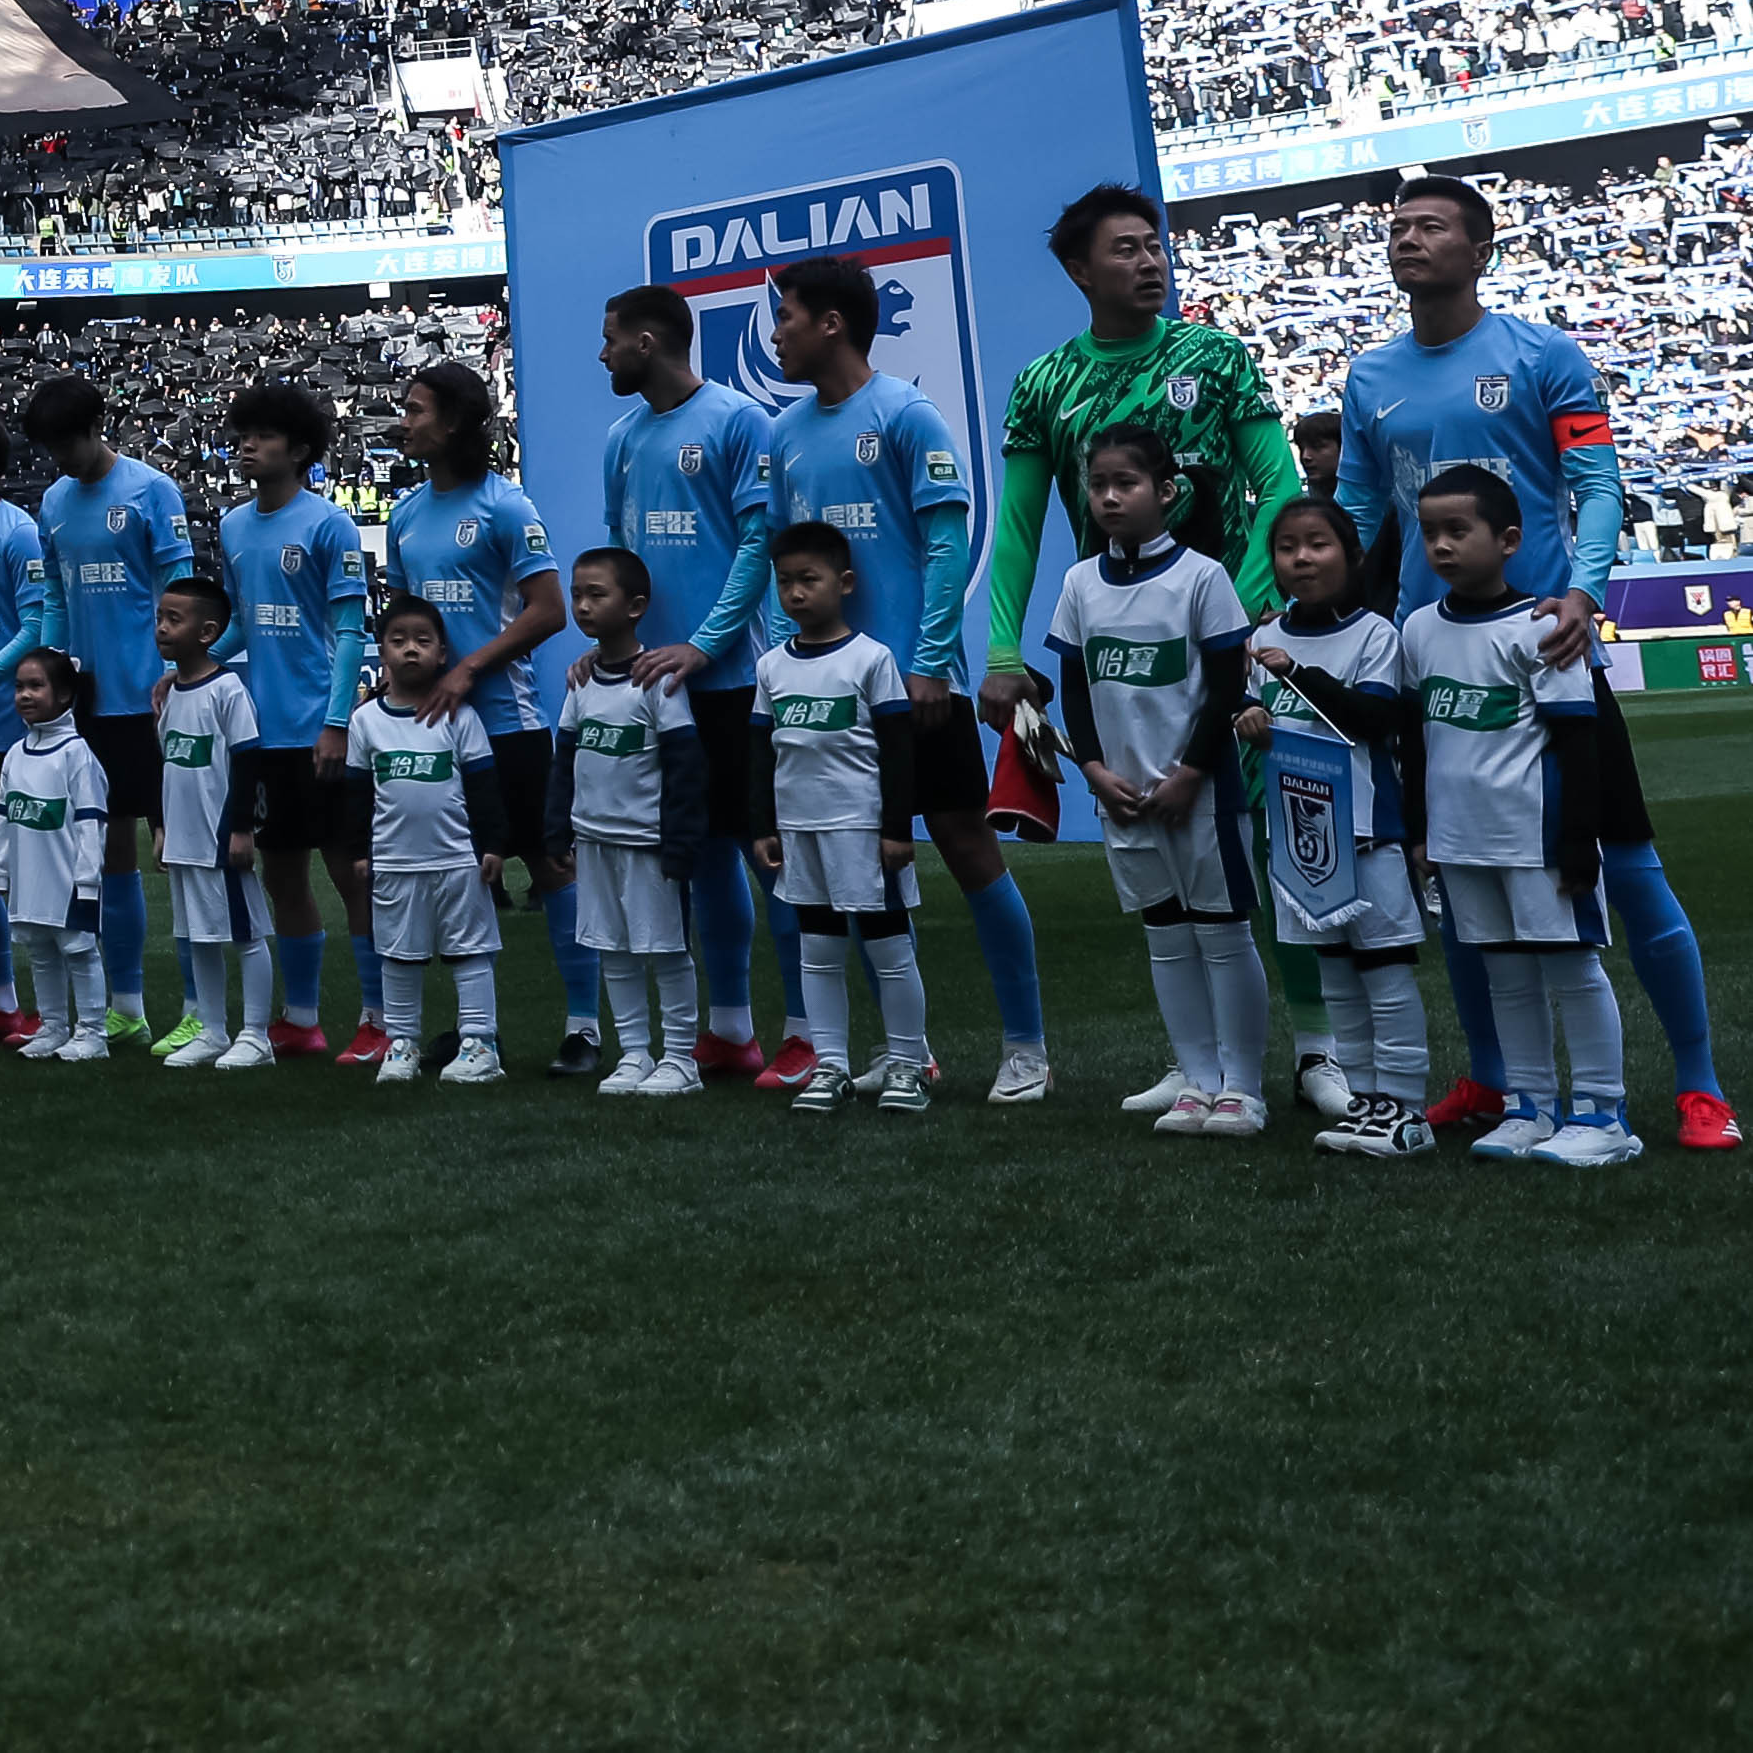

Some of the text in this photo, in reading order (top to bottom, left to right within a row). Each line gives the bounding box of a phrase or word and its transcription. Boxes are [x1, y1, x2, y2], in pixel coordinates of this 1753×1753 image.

[671, 183, 932, 273] DALIAN
[1096, 645, 1159, 678] 怡寶
[780, 700, 835, 726] 怡寶
[1427, 688, 1490, 721] 怡寶
[579, 725, 624, 750] 怡寶
[388, 754, 438, 778] 怡寶
[1282, 775, 1330, 796] DALIAN
